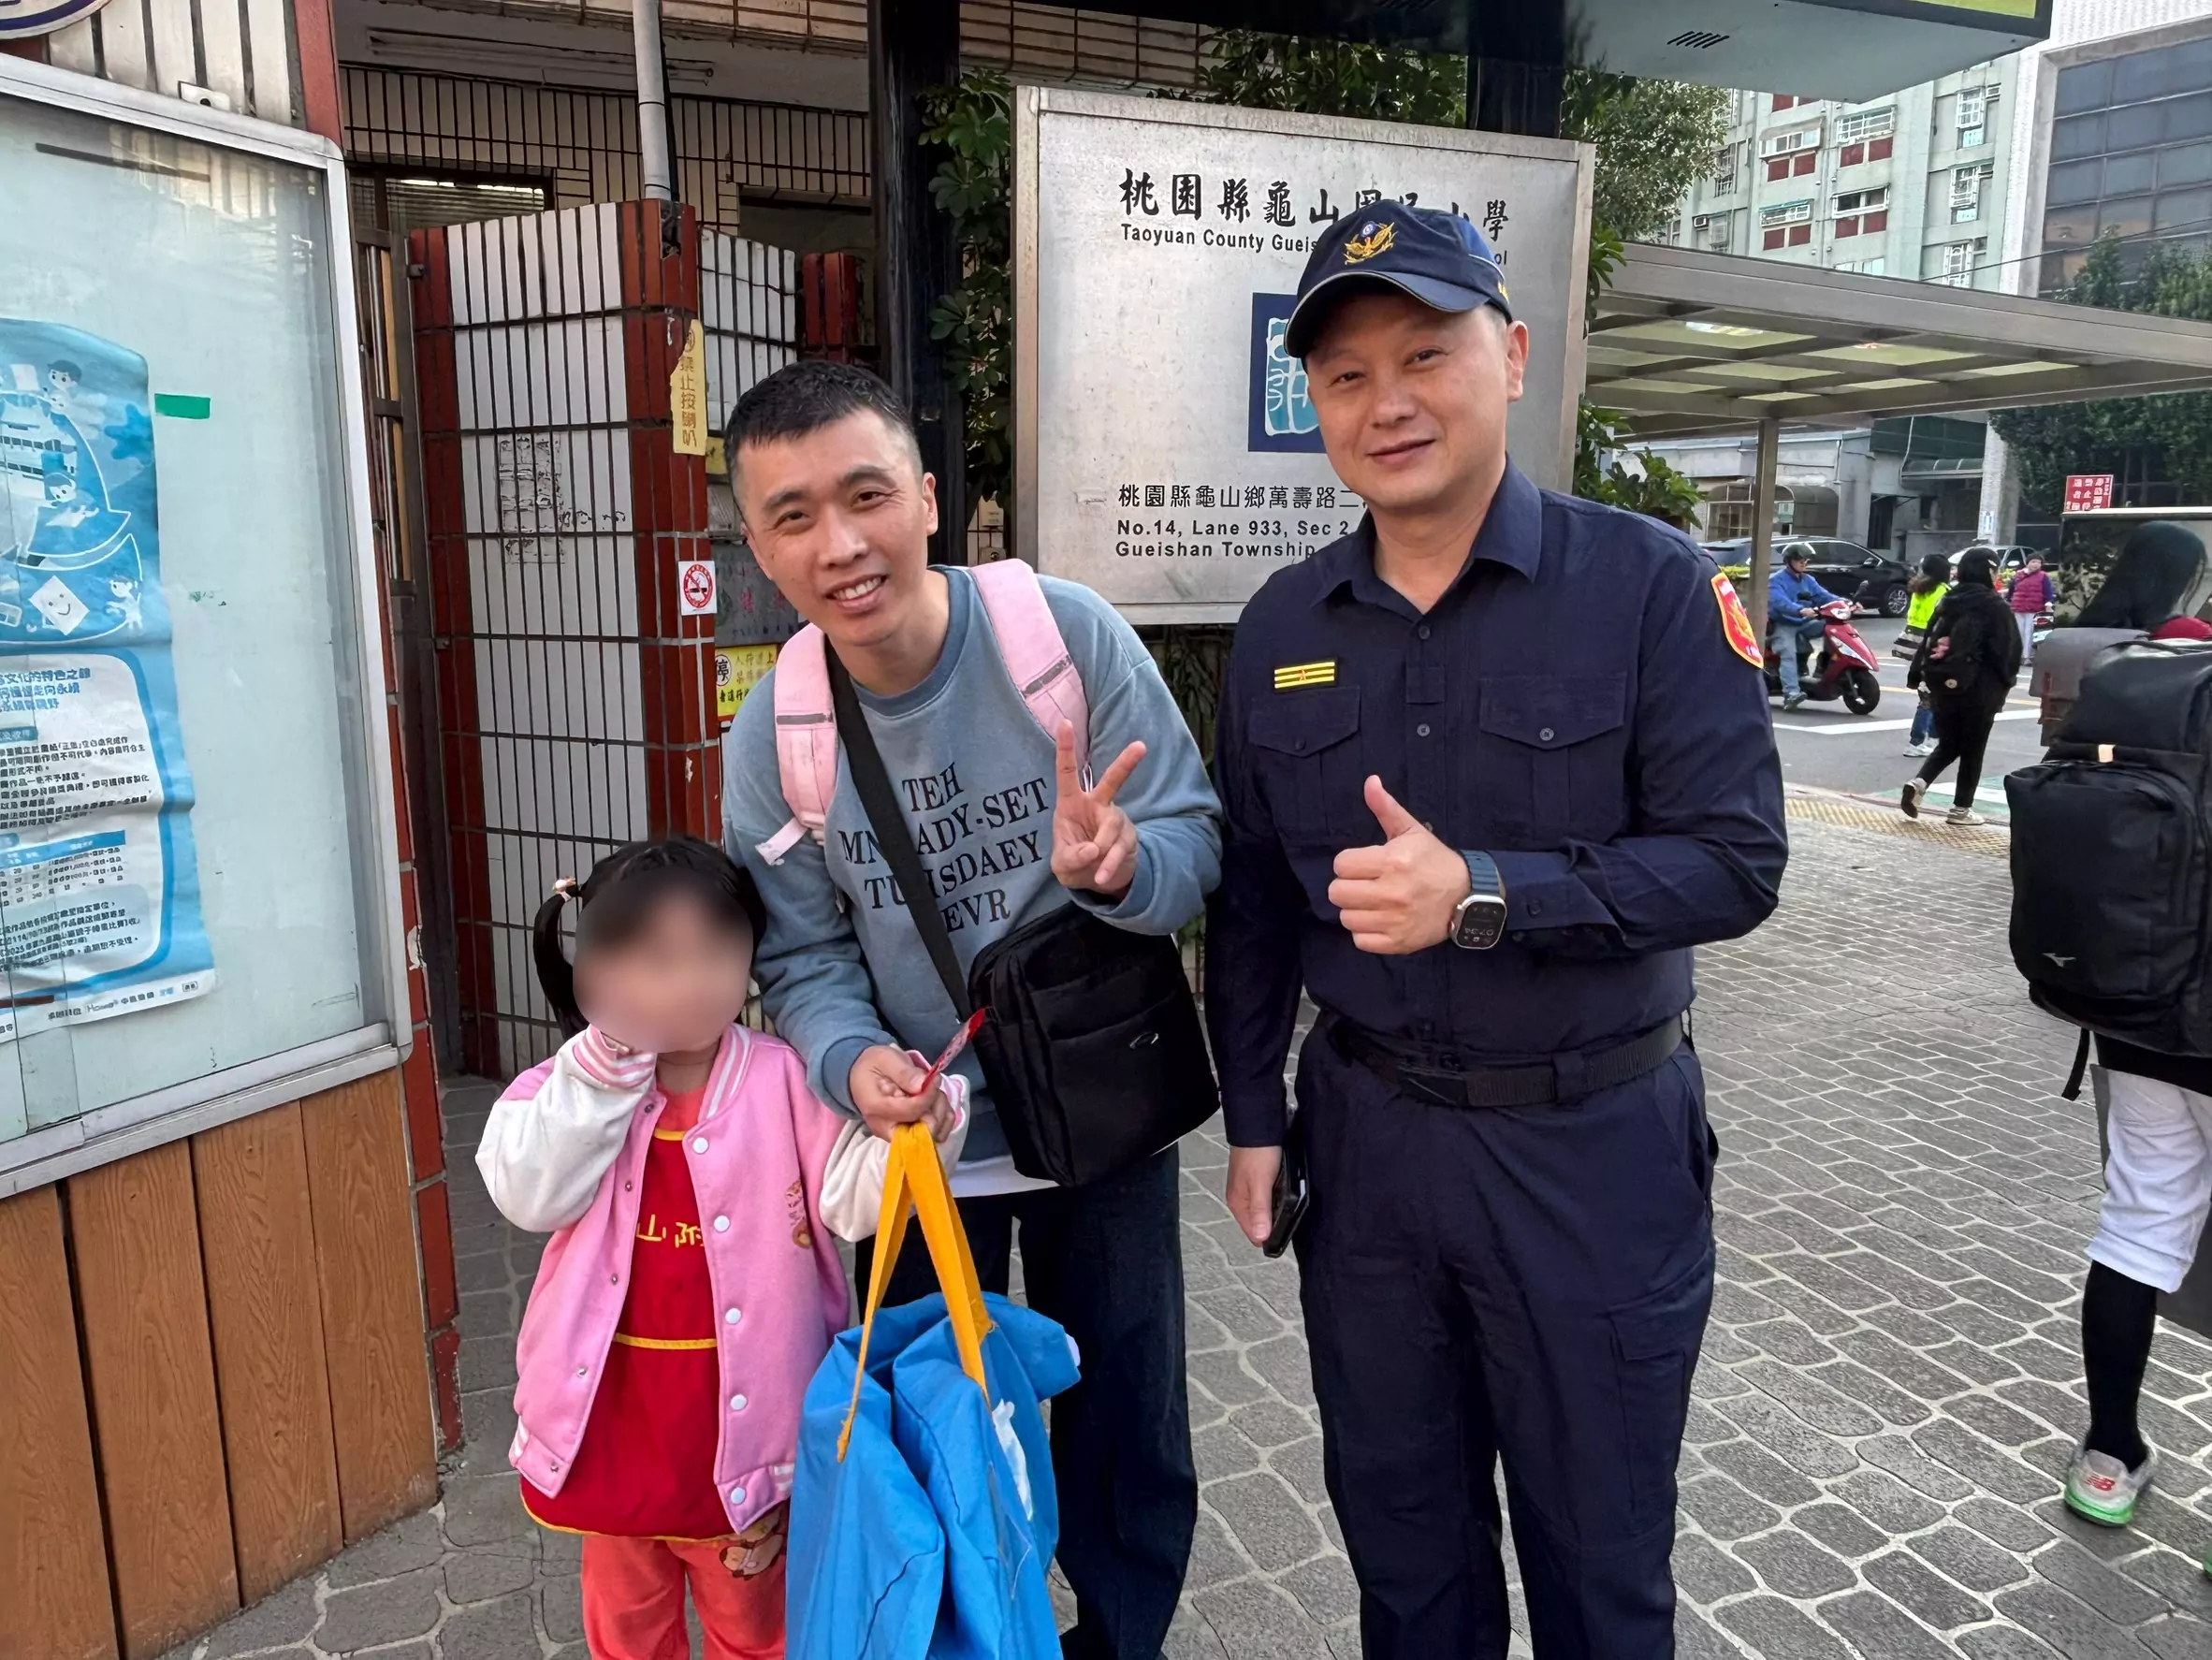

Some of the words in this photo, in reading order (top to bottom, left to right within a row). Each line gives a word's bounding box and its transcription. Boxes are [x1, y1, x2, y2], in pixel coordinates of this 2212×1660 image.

[1119, 167, 1509, 242] 桃園縣龜山學
[1121, 223, 1196, 246] Taoyuan
[1203, 228, 1265, 253] County
[1272, 234, 1318, 253] Gueis
[1118, 483, 1366, 510] 桃園縣龜山鄉萬壽路二
[1117, 519, 1183, 538] No.14,
[1192, 520, 1240, 536] Lane
[1248, 520, 1288, 538] 933,
[1297, 520, 1331, 535] Sec
[1115, 541, 1213, 558] Gueishan
[902, 762, 964, 812] TEH
